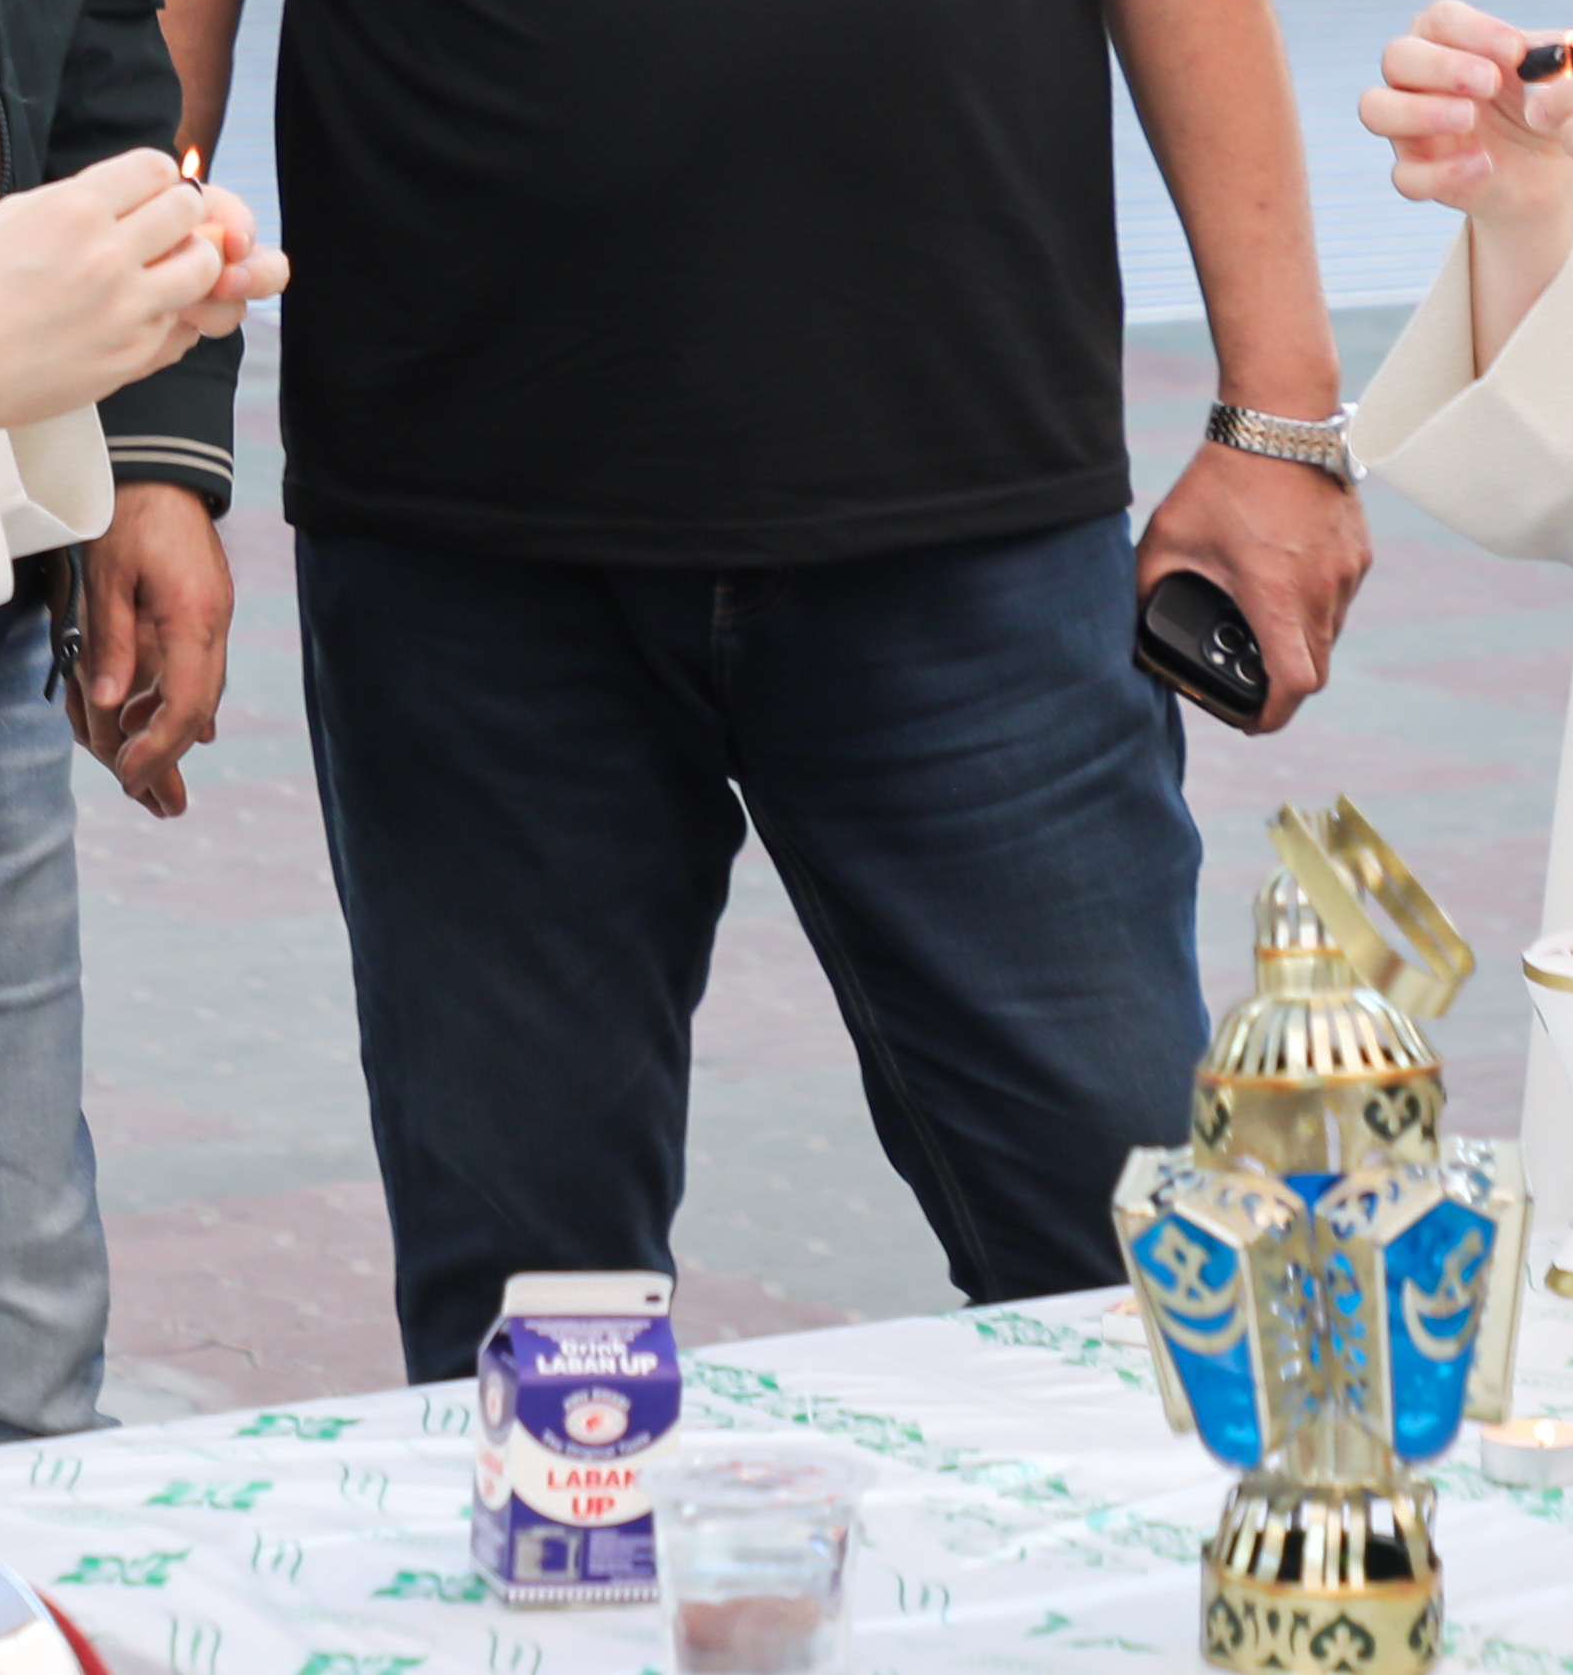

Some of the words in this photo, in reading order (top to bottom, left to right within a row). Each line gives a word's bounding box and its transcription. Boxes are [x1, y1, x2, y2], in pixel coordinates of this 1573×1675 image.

[535, 1354, 618, 1376] LABAN
[619, 1352, 659, 1376] UP
[572, 1497, 616, 1519] UP
